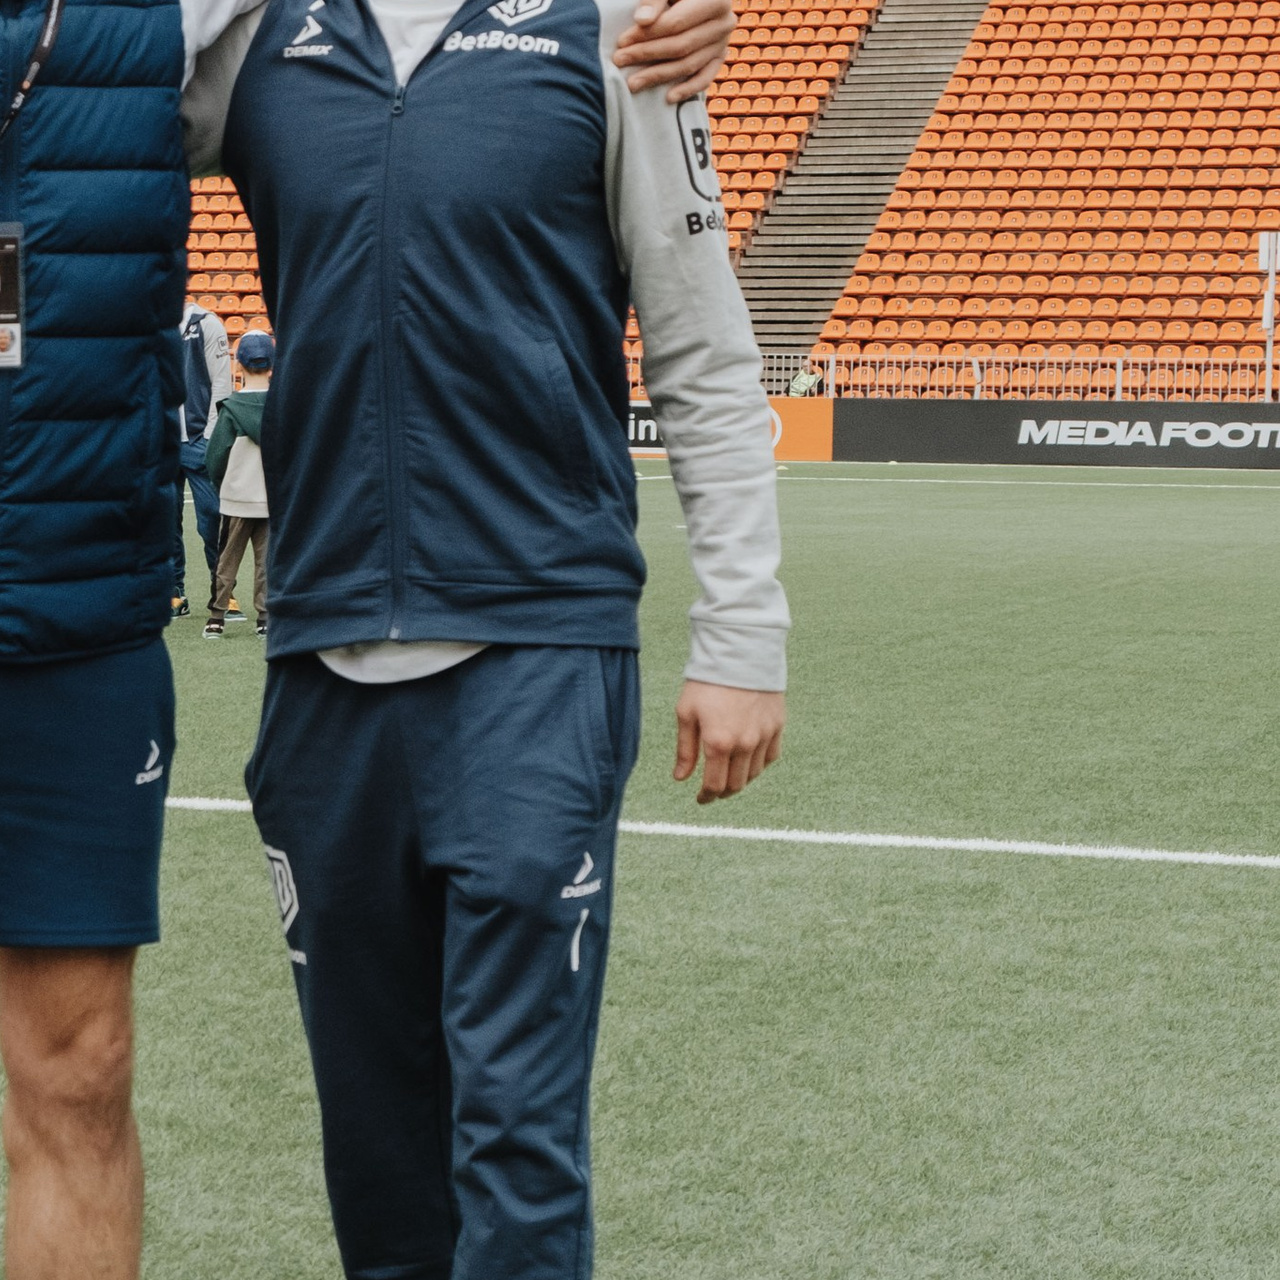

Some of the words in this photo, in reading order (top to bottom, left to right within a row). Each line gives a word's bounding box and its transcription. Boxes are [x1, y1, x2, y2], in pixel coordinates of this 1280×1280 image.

[283, 44, 334, 58] DEMIX
[443, 30, 560, 56] BetBoom
[1018, 419, 1157, 447] MEDIA
[1159, 421, 1280, 448] FOOT
